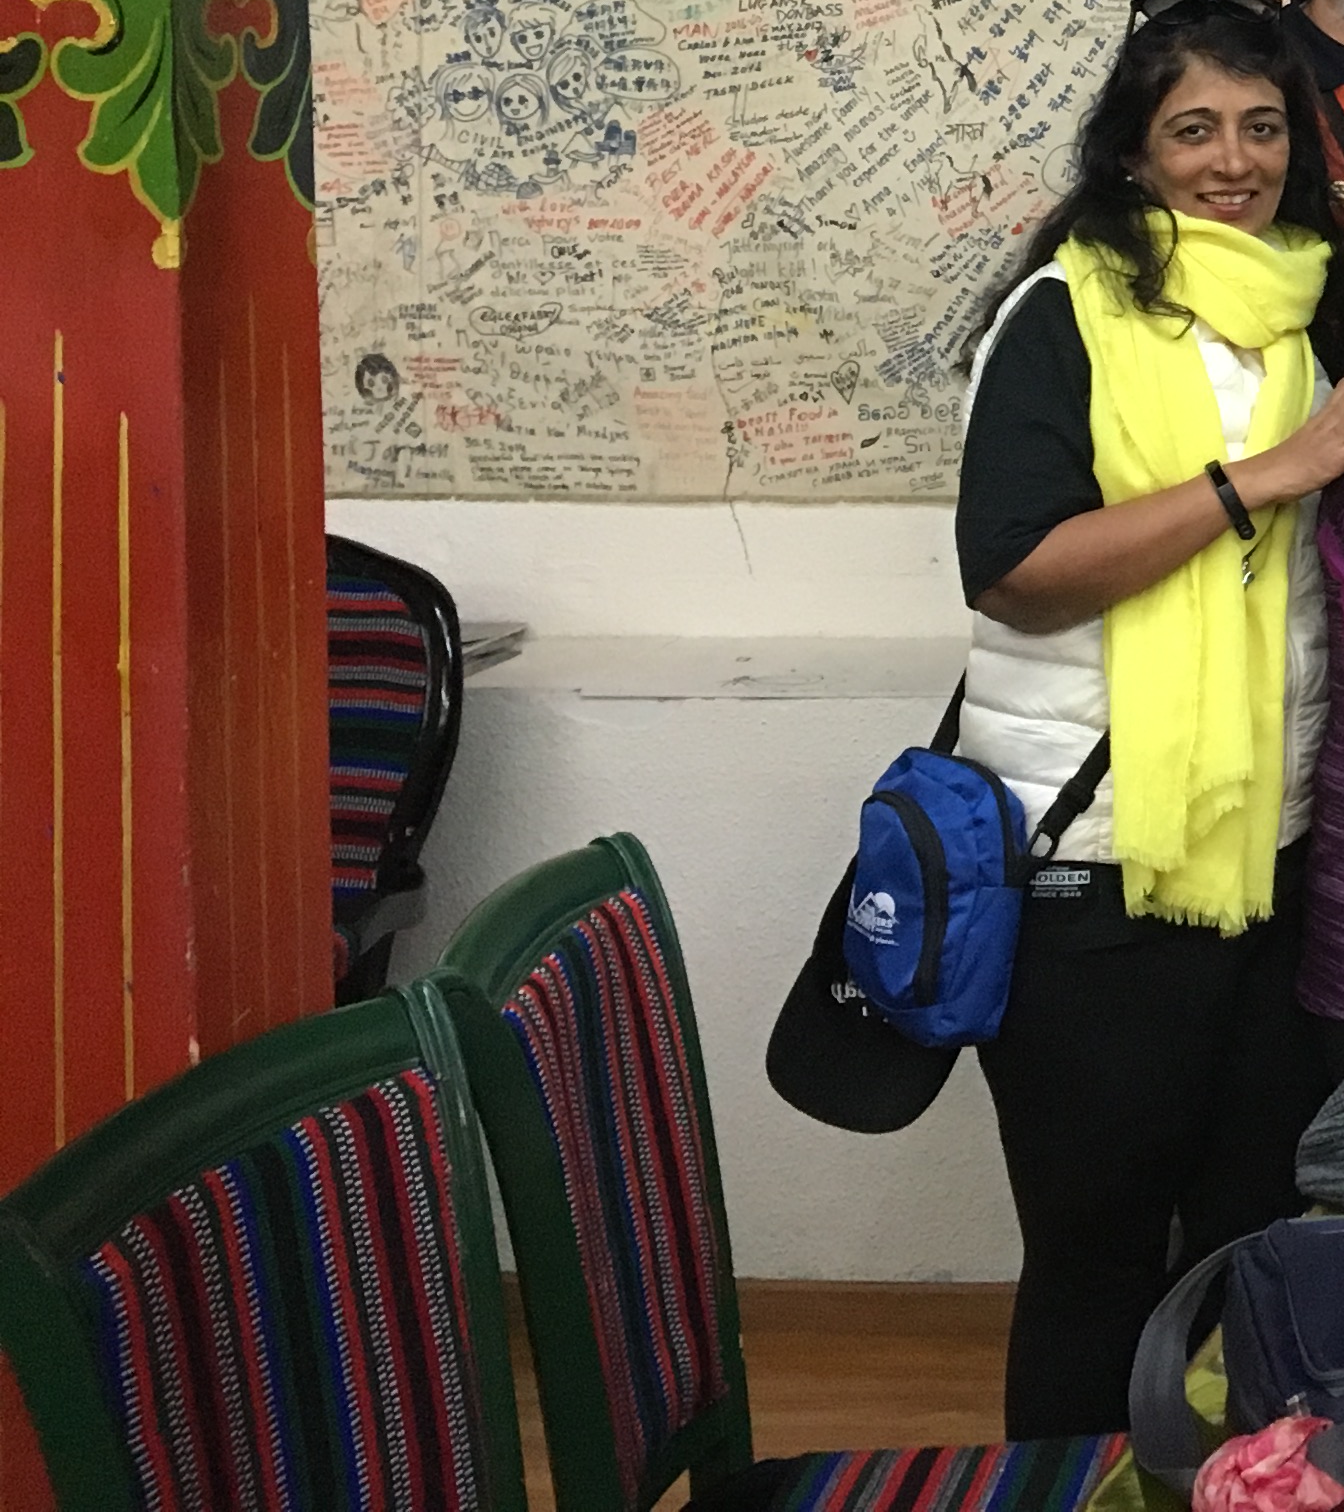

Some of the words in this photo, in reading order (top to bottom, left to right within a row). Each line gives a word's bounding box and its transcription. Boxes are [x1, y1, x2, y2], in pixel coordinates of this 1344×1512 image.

[859, 142, 877, 163] for
[877, 123, 899, 141] the
[901, 89, 934, 121] unique
[796, 143, 848, 183] Amazing
[853, 144, 900, 187] experience
